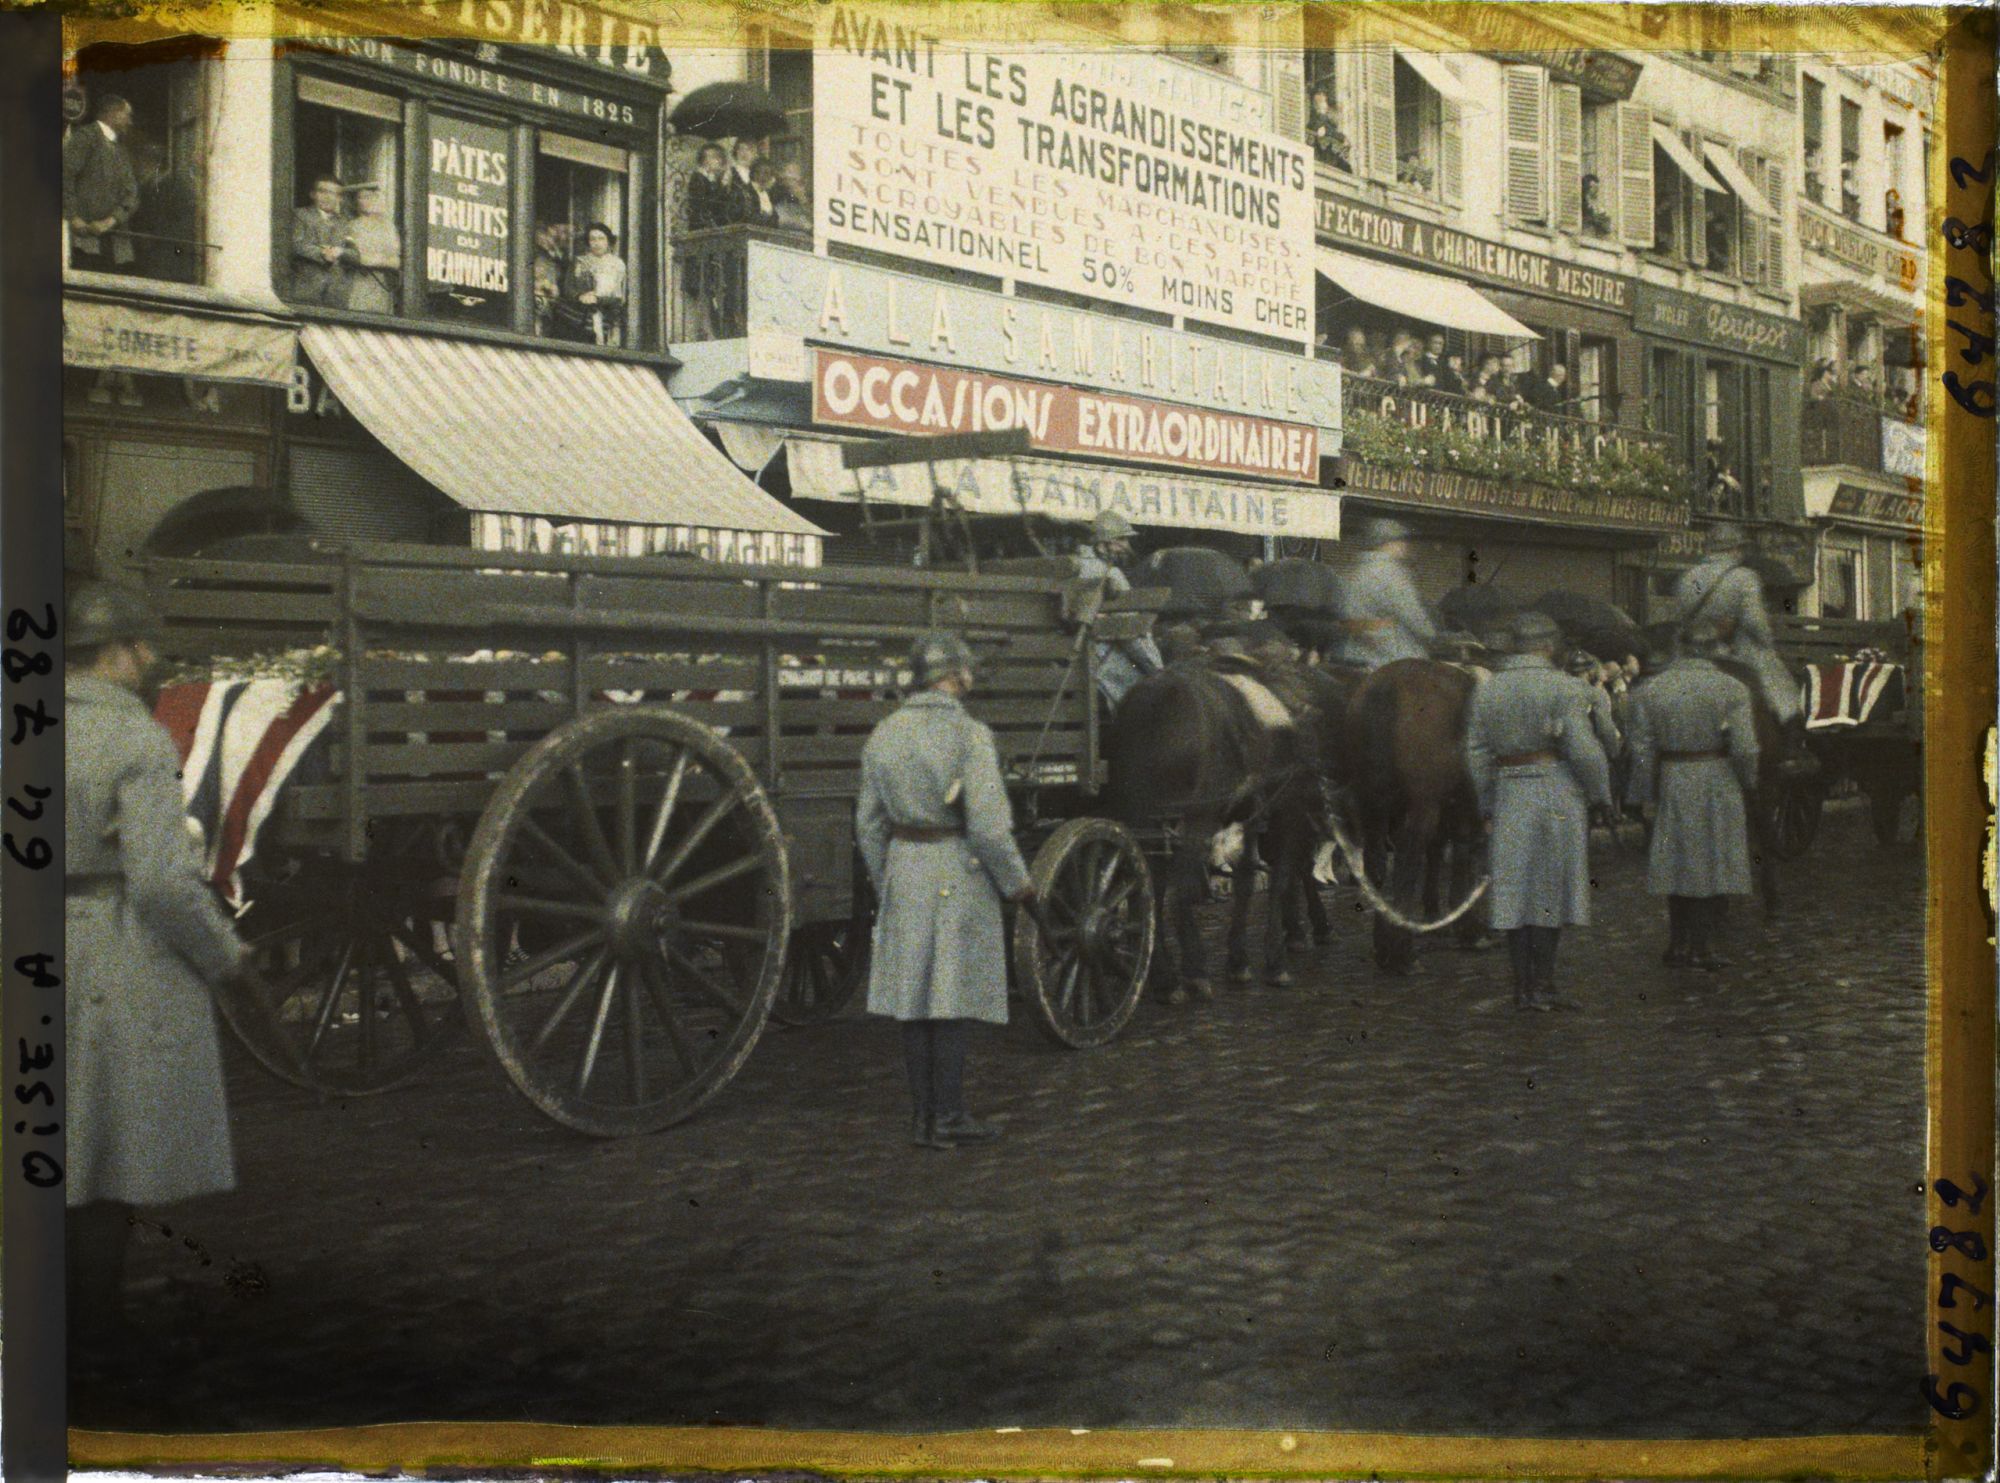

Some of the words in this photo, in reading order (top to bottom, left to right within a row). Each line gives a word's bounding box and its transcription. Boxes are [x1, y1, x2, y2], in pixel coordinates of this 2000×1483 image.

[296, 17, 395, 64] MAISON
[532, 82, 559, 107] EN
[582, 95, 633, 124] 1825
[424, 0, 655, 74] ISERIE
[829, 4, 940, 78] AVANT
[964, 50, 1027, 107] LES
[1050, 78, 1305, 191] AGRANDISSEMENTS
[432, 138, 508, 187] PÂTES
[852, 124, 981, 176] TOUTES
[1014, 169, 1069, 198] LES
[871, 72, 912, 126] ET
[936, 91, 996, 150] LES
[1017, 116, 1281, 230] TRANSFORMATIONS
[428, 193, 508, 239] FRUITS
[457, 182, 480, 196] DE
[836, 173, 1066, 245] INCROYABLES
[1084, 233, 1117, 257] DE
[1135, 246, 1185, 273] BON
[849, 150, 937, 190] SONT
[966, 179, 1106, 231] VENDUES
[1240, 250, 1295, 280] PRIX
[427, 247, 509, 293] BEAUVAISIS
[457, 235, 480, 250] DU
[828, 197, 1049, 273] SENSATIONNEL
[1082, 256, 1134, 294] 50%
[1162, 274, 1234, 316] MOINS
[1255, 296, 1308, 331] CHER
[1412, 226, 1424, 255] A
[1432, 229, 1550, 289] CHARLEMAGNE
[1556, 267, 1626, 306] MESURE
[819, 266, 850, 337] A
[887, 277, 957, 354] LA
[1003, 302, 1298, 414] SAMARITAINE
[823, 360, 1055, 440] OCCASIONS
[1078, 397, 1314, 475] EXTRAORDINAIRES
[1011, 470, 1290, 527] SAMARITAINE
[1429, 470, 1462, 499] TOUT
[1531, 485, 1574, 513] MESURE
[14, 953, 61, 988] A
